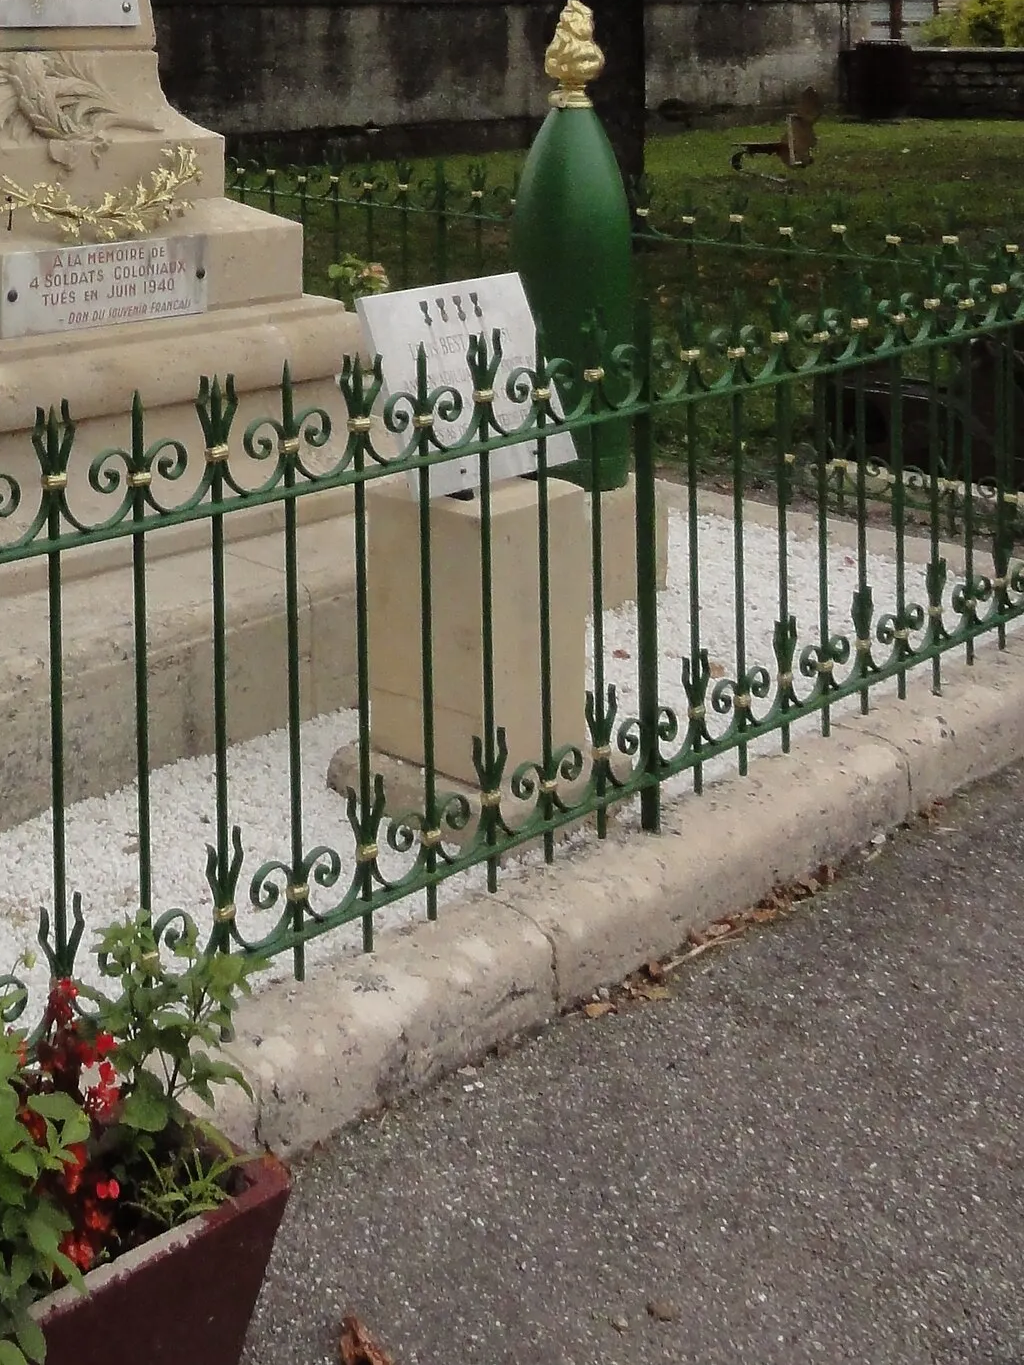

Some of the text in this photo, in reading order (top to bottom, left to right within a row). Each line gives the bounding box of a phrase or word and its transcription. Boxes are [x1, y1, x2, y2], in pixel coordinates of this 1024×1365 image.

[53, 254, 63, 268] A
[68, 254, 82, 267] LA
[151, 247, 166, 258] DE
[29, 261, 186, 290] 4 SOLDATS COLONIAUX
[84, 290, 98, 302] EN
[107, 282, 137, 299] JUIN
[143, 278, 175, 295] 1940
[68, 311, 89, 324] DON
[92, 308, 106, 321] DU
[108, 302, 148, 319] SOUVENIR
